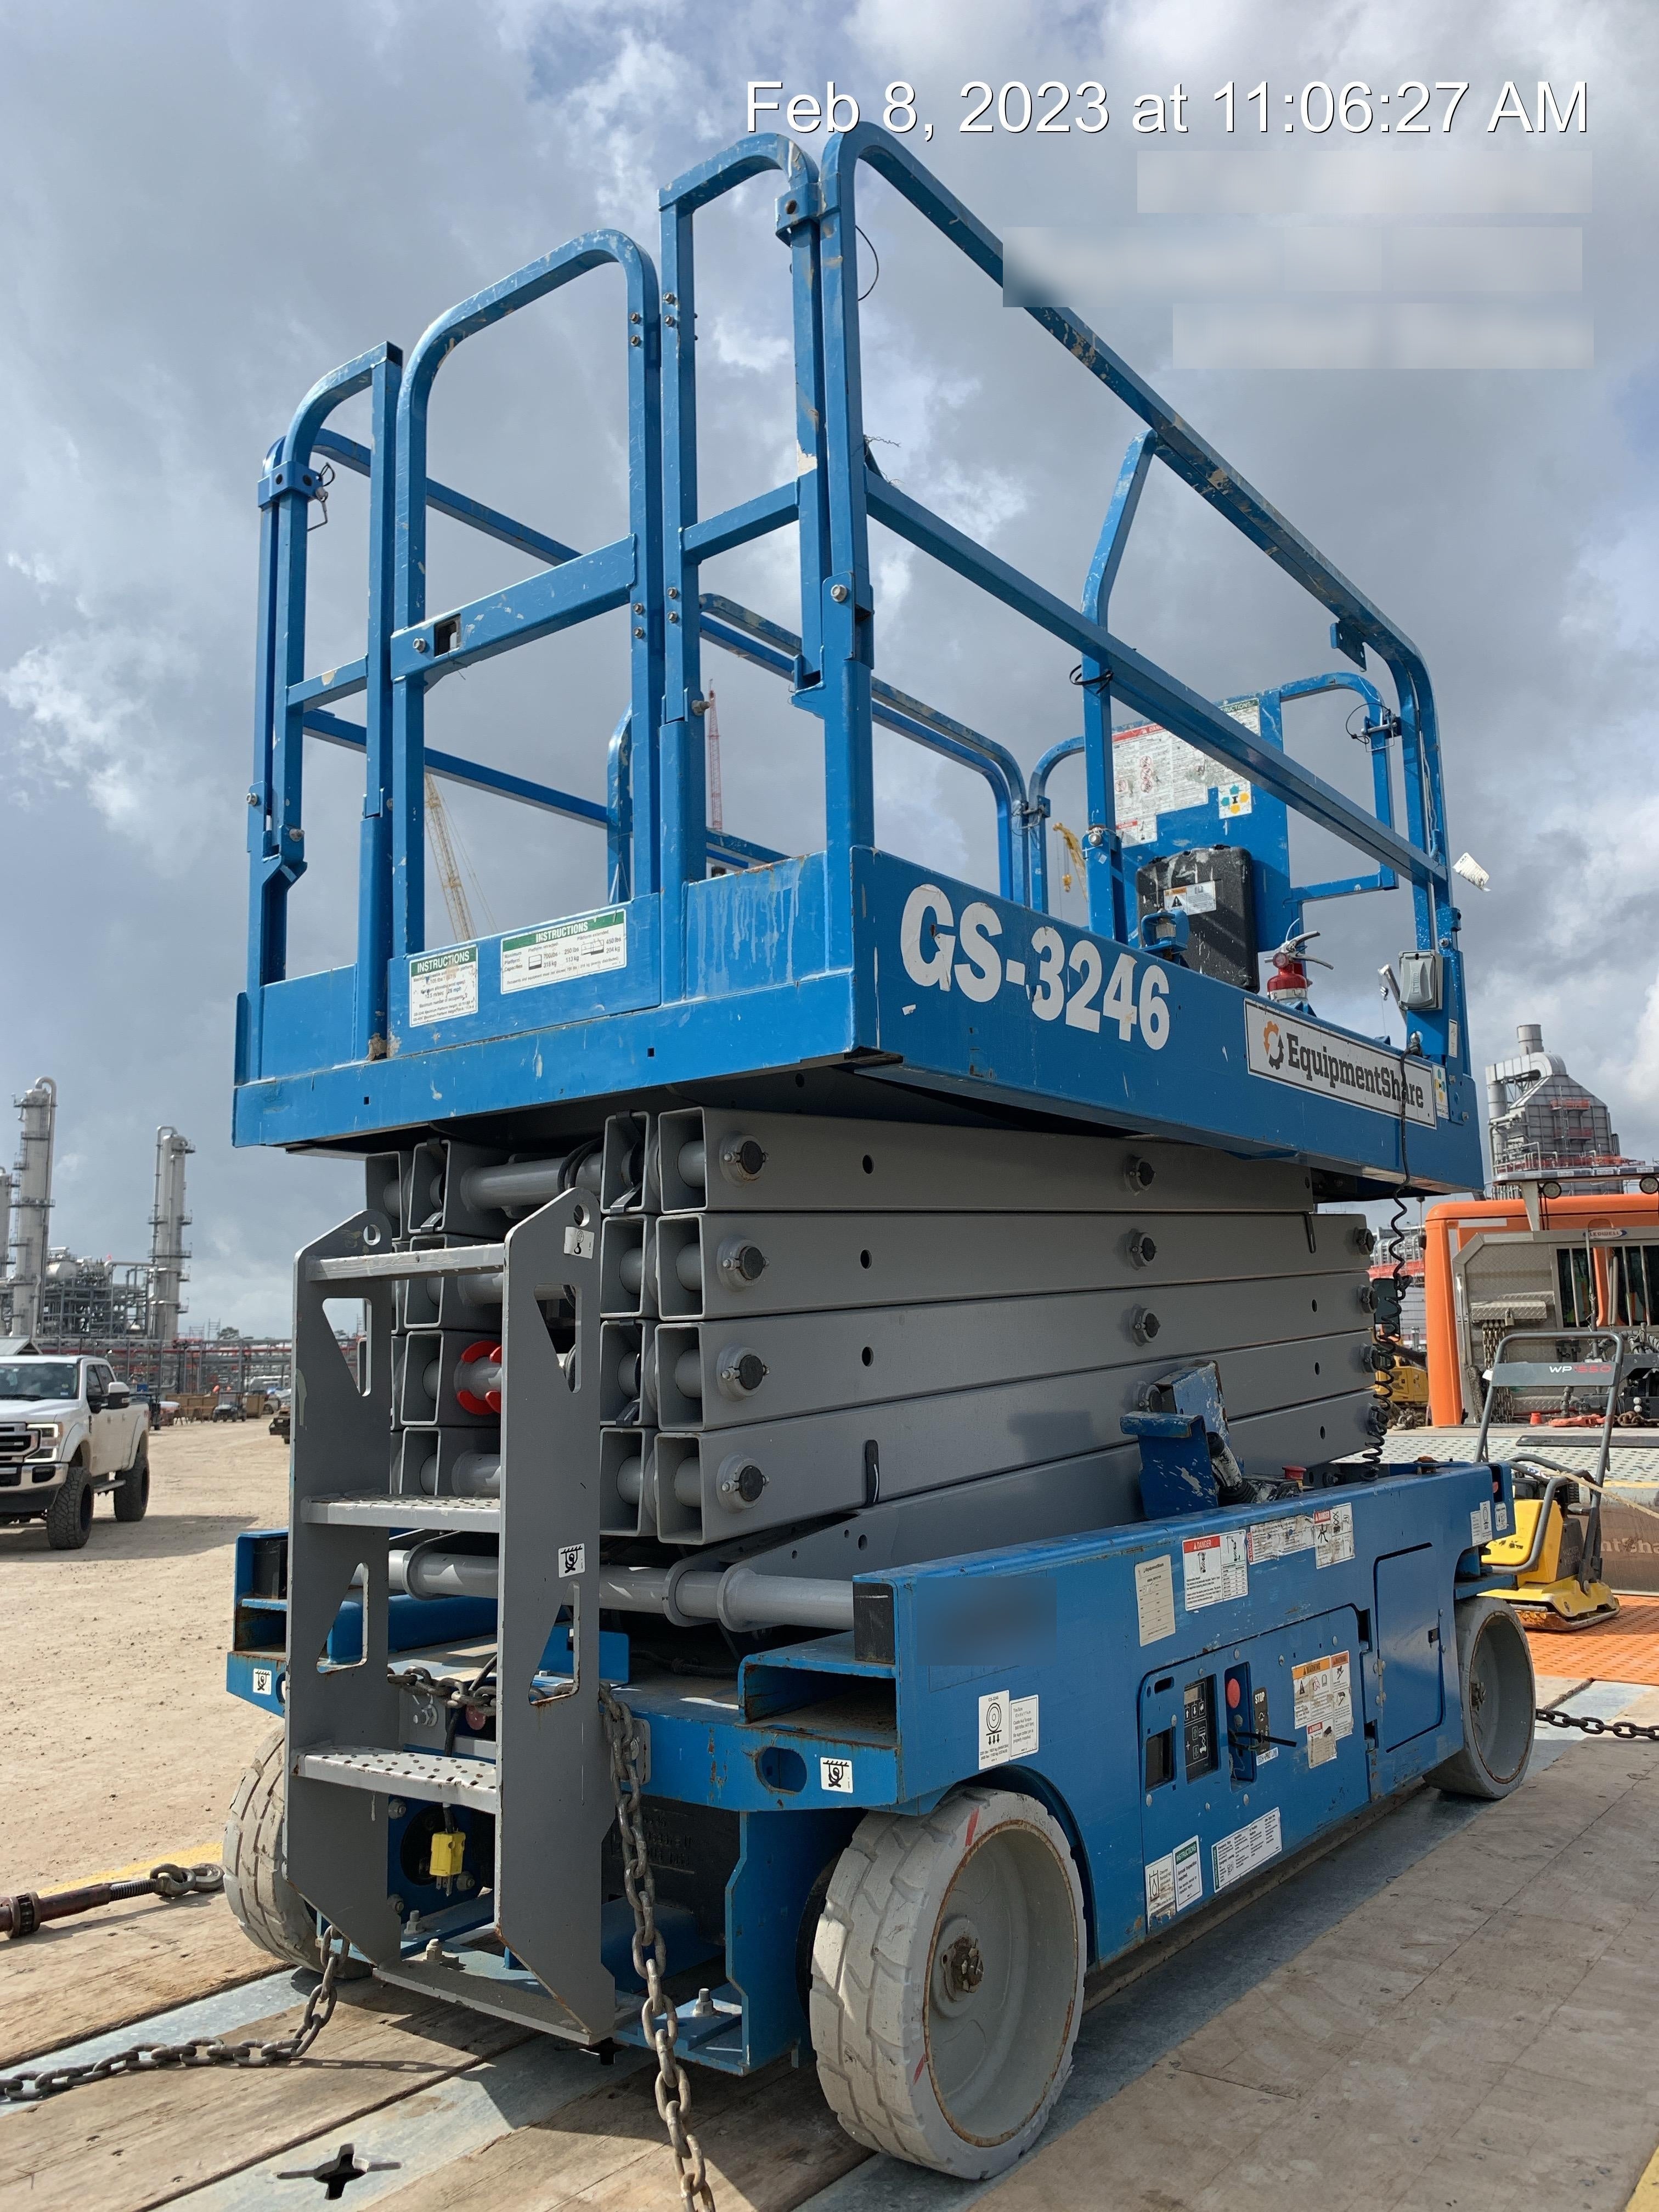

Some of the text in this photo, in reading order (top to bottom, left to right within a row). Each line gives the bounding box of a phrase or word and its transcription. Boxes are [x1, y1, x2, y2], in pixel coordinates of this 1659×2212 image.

[536, 922, 588, 943] INSTRUCTIONS
[417, 951, 469, 973] INSTRUCTIONS
[900, 884, 1170, 1050] GS-3246
[1197, 1539, 1211, 1549] DANGER
[1307, 1662, 1321, 1674] WARNING
[1255, 1691, 1265, 1704] STOP
